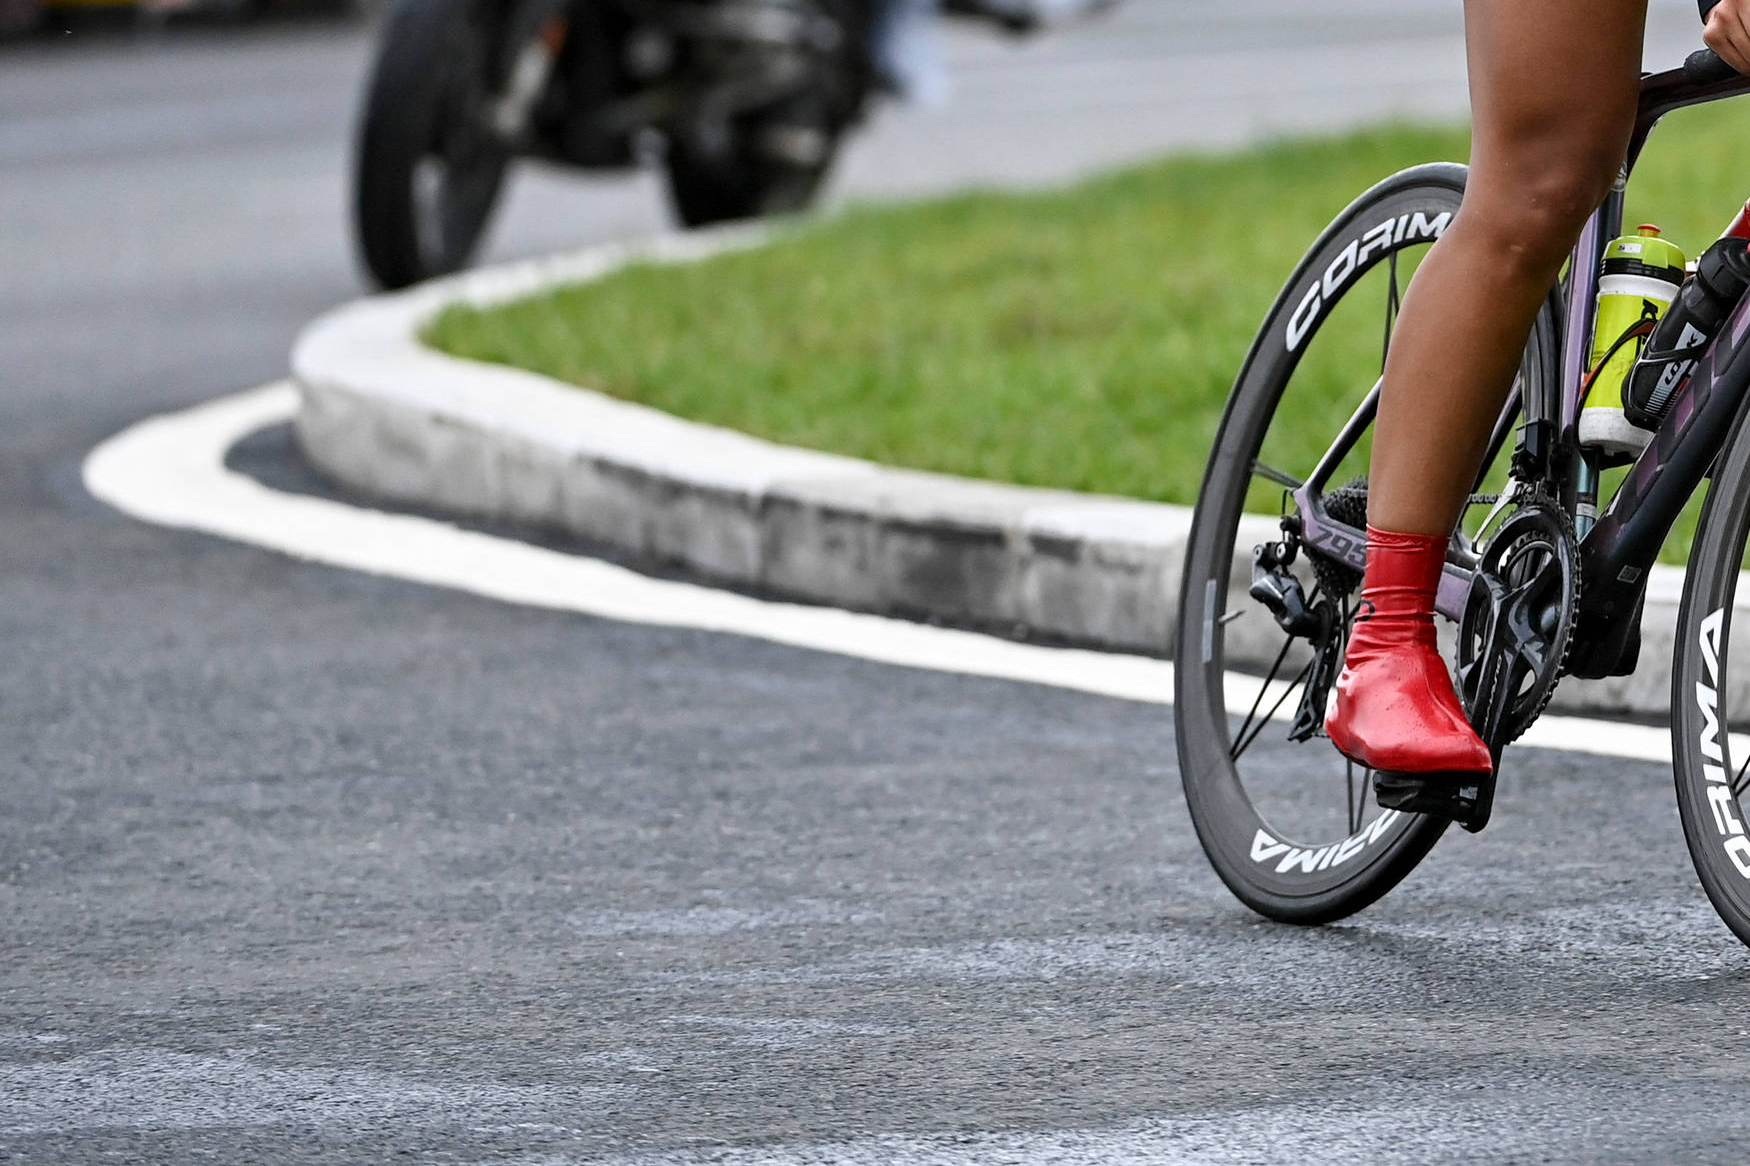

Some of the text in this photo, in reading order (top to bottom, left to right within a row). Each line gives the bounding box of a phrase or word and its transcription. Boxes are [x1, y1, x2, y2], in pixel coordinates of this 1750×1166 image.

[1286, 212, 1454, 352] CORIM
[1665, 333, 1698, 385] LOK
[1311, 526, 1366, 566] 795
[1250, 808, 1401, 873] ORIMA
